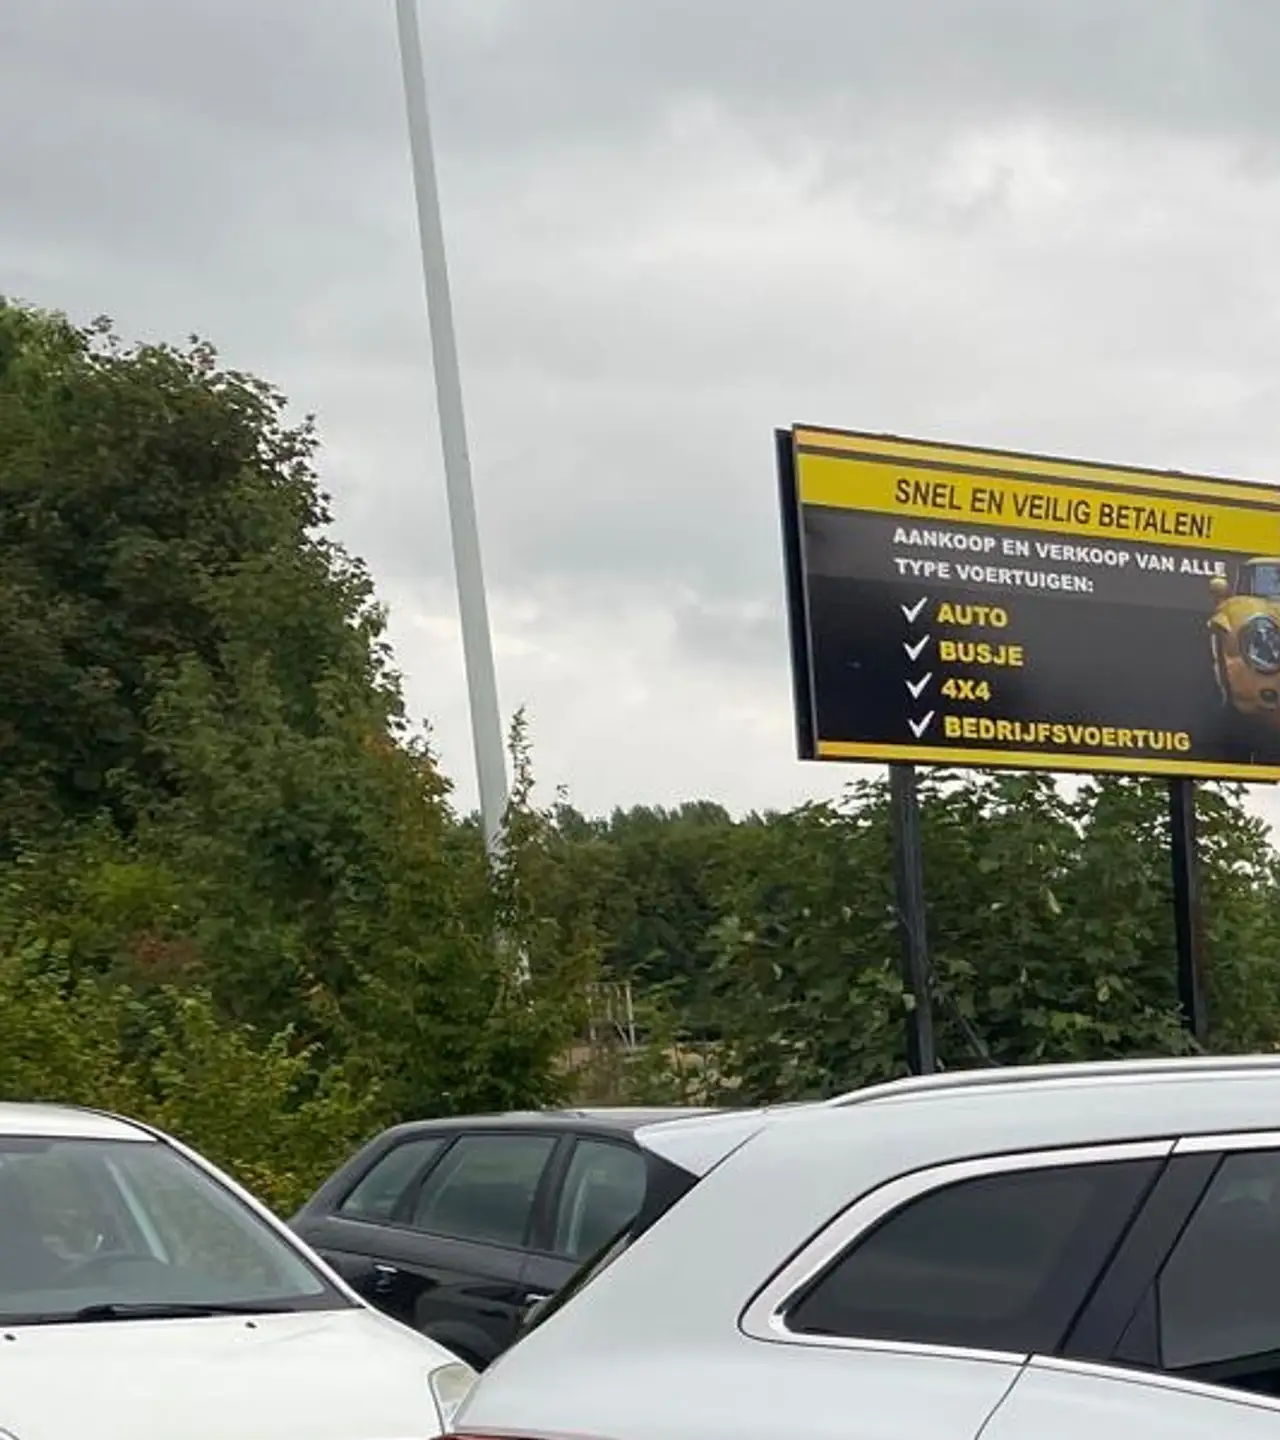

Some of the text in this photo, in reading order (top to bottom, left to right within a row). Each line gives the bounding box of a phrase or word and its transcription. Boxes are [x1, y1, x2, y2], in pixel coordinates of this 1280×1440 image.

[895, 479, 1213, 538] SNEL EN VEILIG BETALEN!
[893, 527, 1227, 577] AANKOOP EN VERKOOP VAN ALLE
[894, 557, 1094, 592] TYPE VOERTUIGEN:
[937, 603, 1008, 628] AUTO
[939, 640, 1024, 666] BUSJE
[944, 715, 1190, 750] BEDRIJFSVOERTUIG
